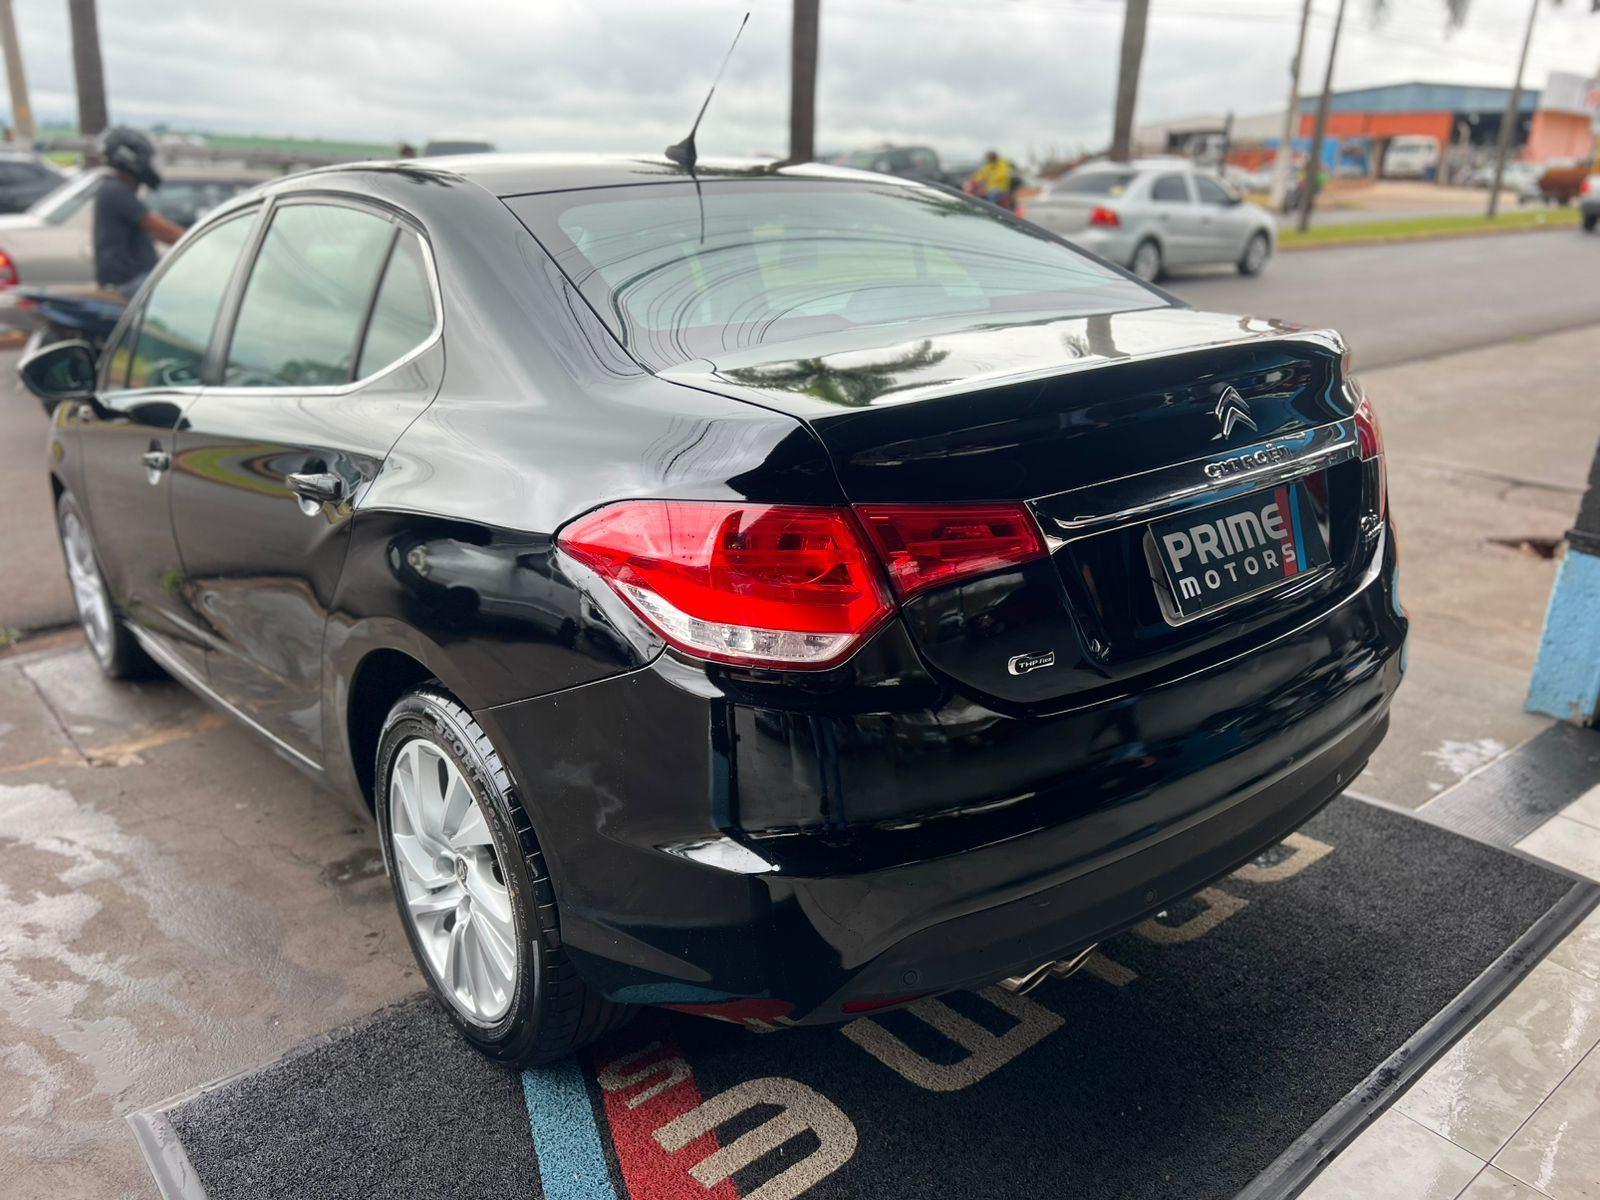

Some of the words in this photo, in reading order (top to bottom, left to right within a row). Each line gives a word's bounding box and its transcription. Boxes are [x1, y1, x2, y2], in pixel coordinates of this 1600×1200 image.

[1203, 441, 1292, 478] CITROËN
[1162, 502, 1287, 573] PRIME
[1179, 542, 1297, 601] MOTORS
[1018, 659, 1038, 669] THP
[434, 715, 484, 784] SPORT
